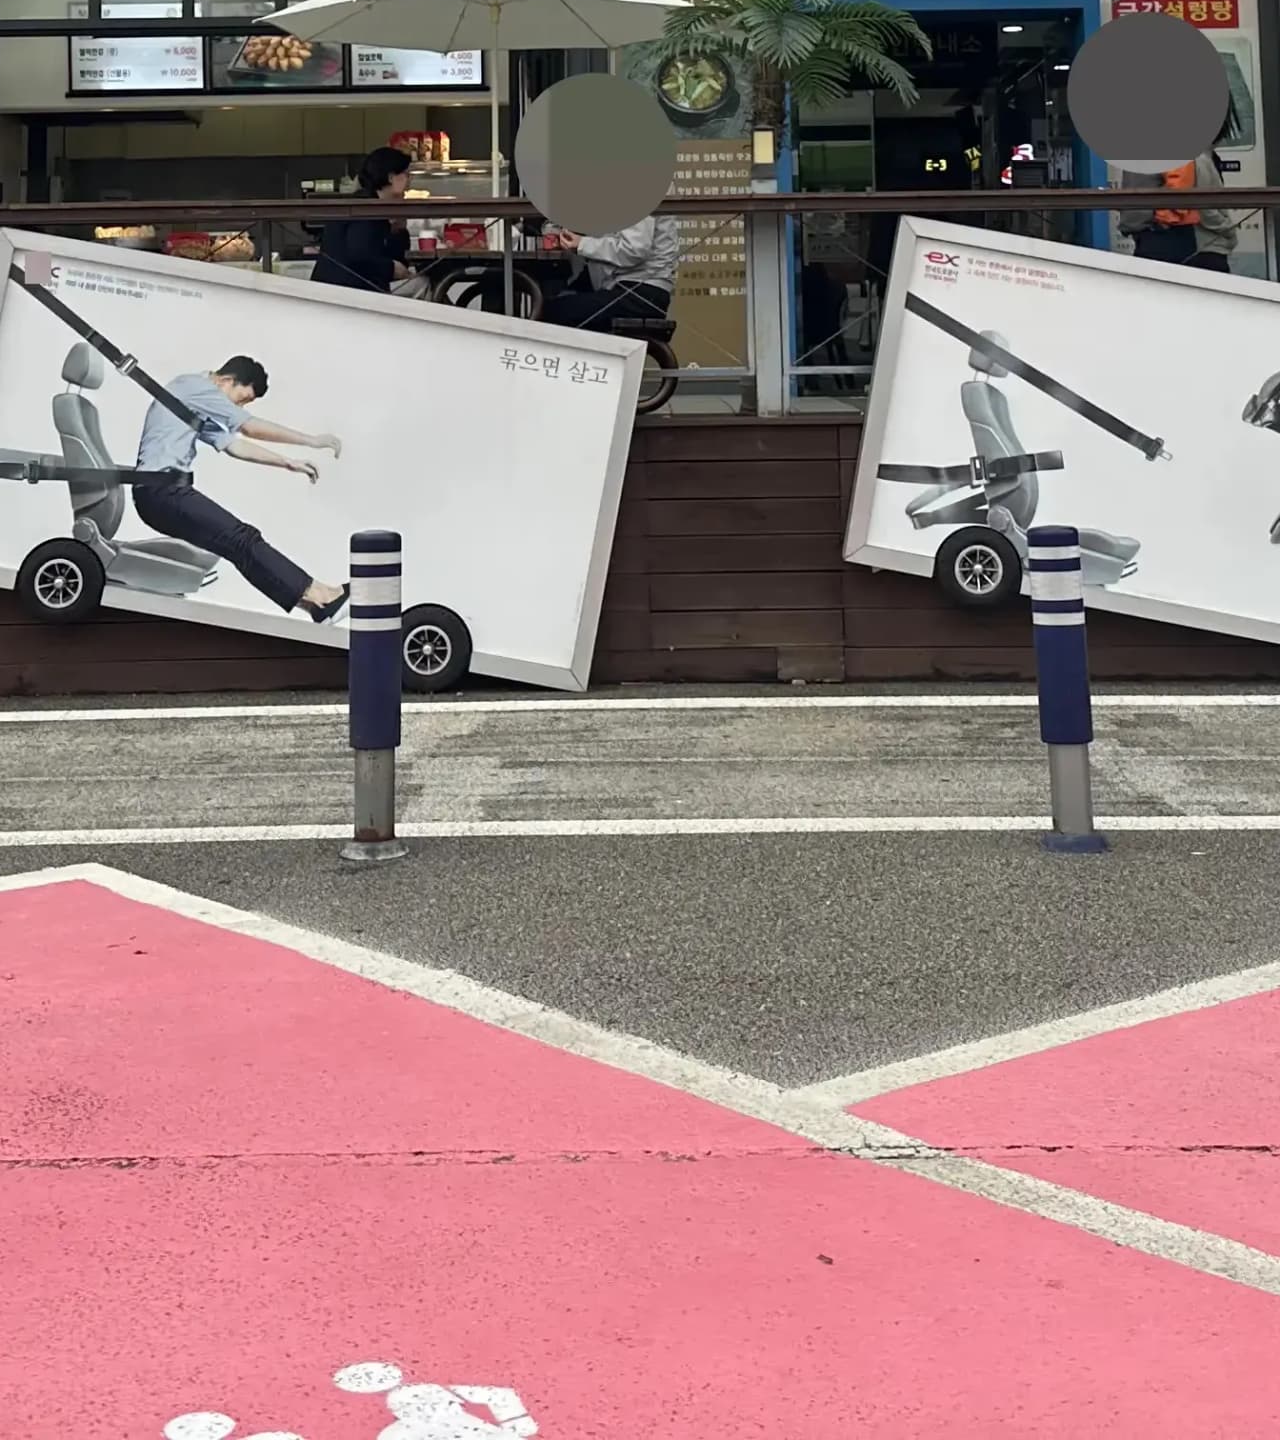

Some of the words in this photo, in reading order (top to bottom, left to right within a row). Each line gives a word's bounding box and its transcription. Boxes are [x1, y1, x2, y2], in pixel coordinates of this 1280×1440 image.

[924, 251, 960, 267] ex
[500, 348, 560, 379] 묶으면
[568, 361, 608, 384] 살고
